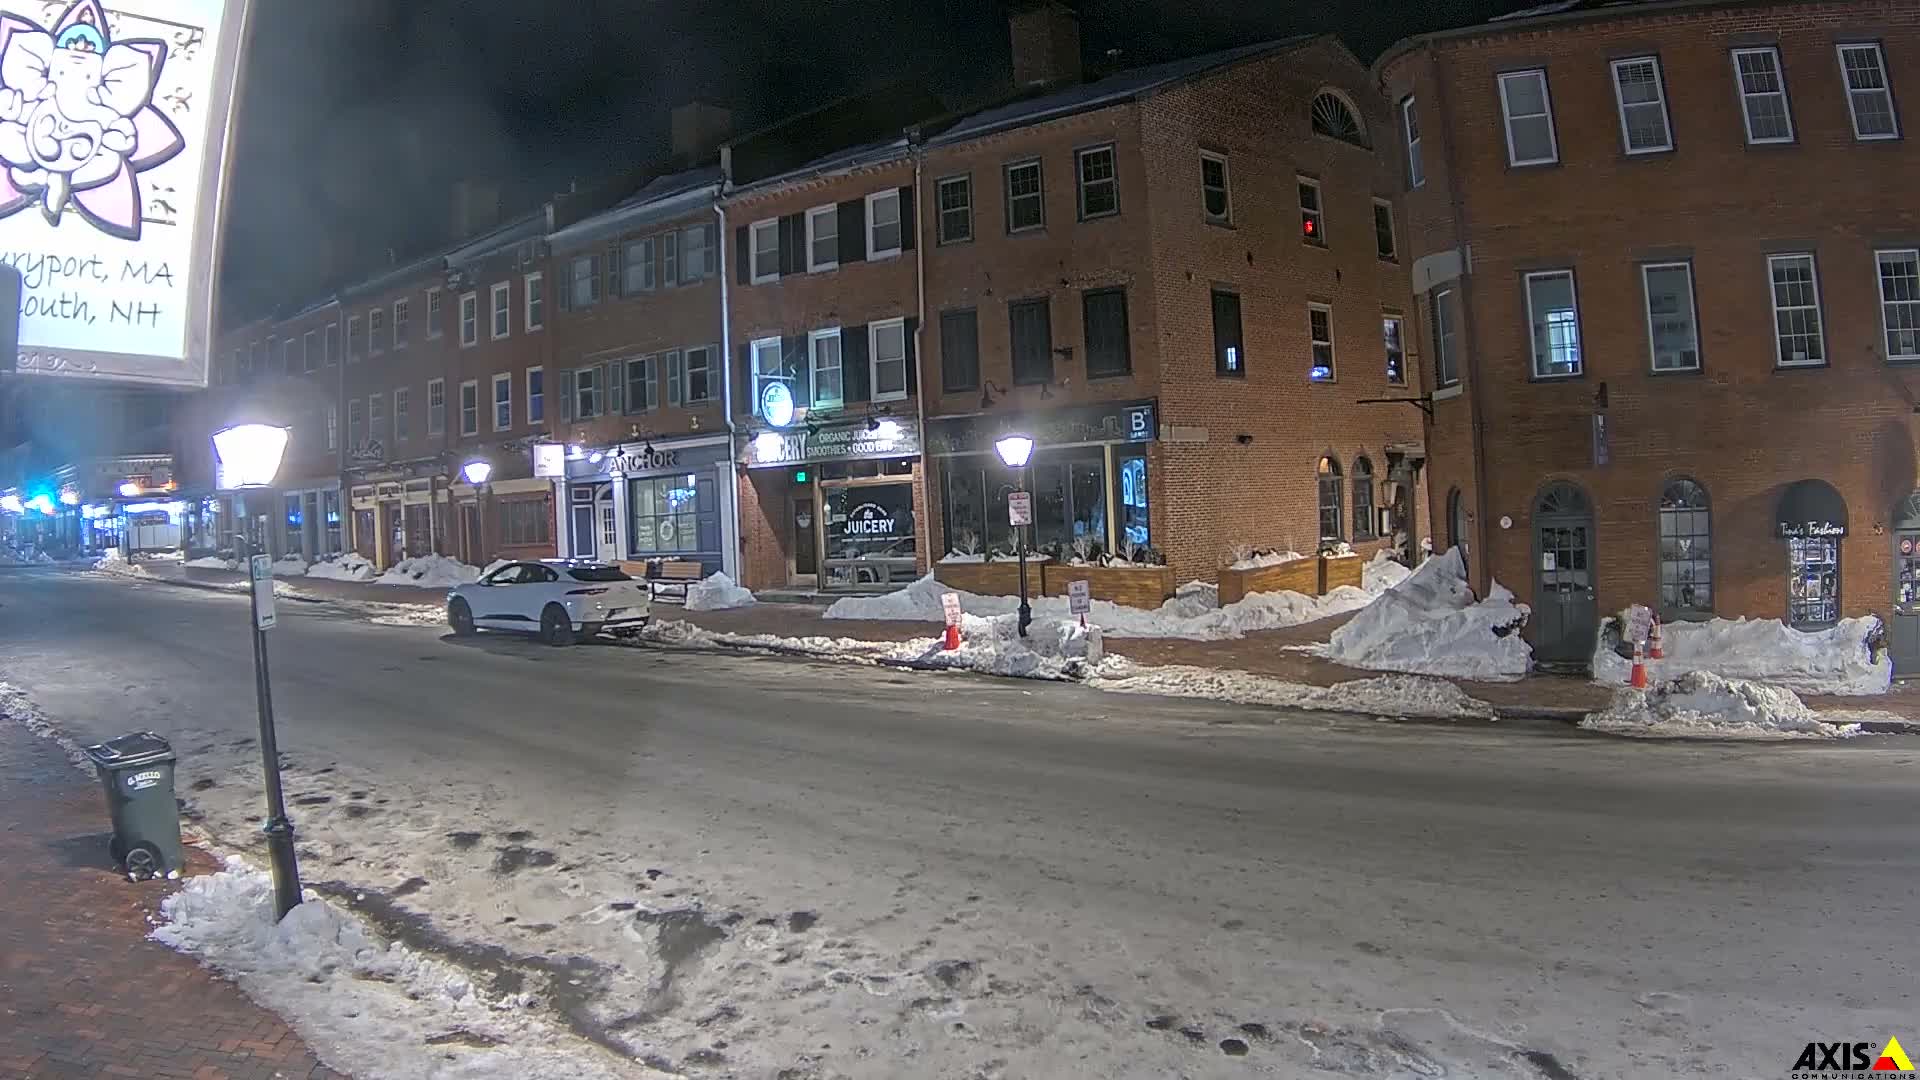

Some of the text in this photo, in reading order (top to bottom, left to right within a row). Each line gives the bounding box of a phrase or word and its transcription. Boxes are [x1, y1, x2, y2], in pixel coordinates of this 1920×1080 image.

[120, 260, 174, 288] MA
[20, 292, 162, 328] outh, NH
[818, 431, 851, 444] ORGANIC
[609, 450, 679, 472] ANCHOR
[844, 519, 895, 534] JUICERY
